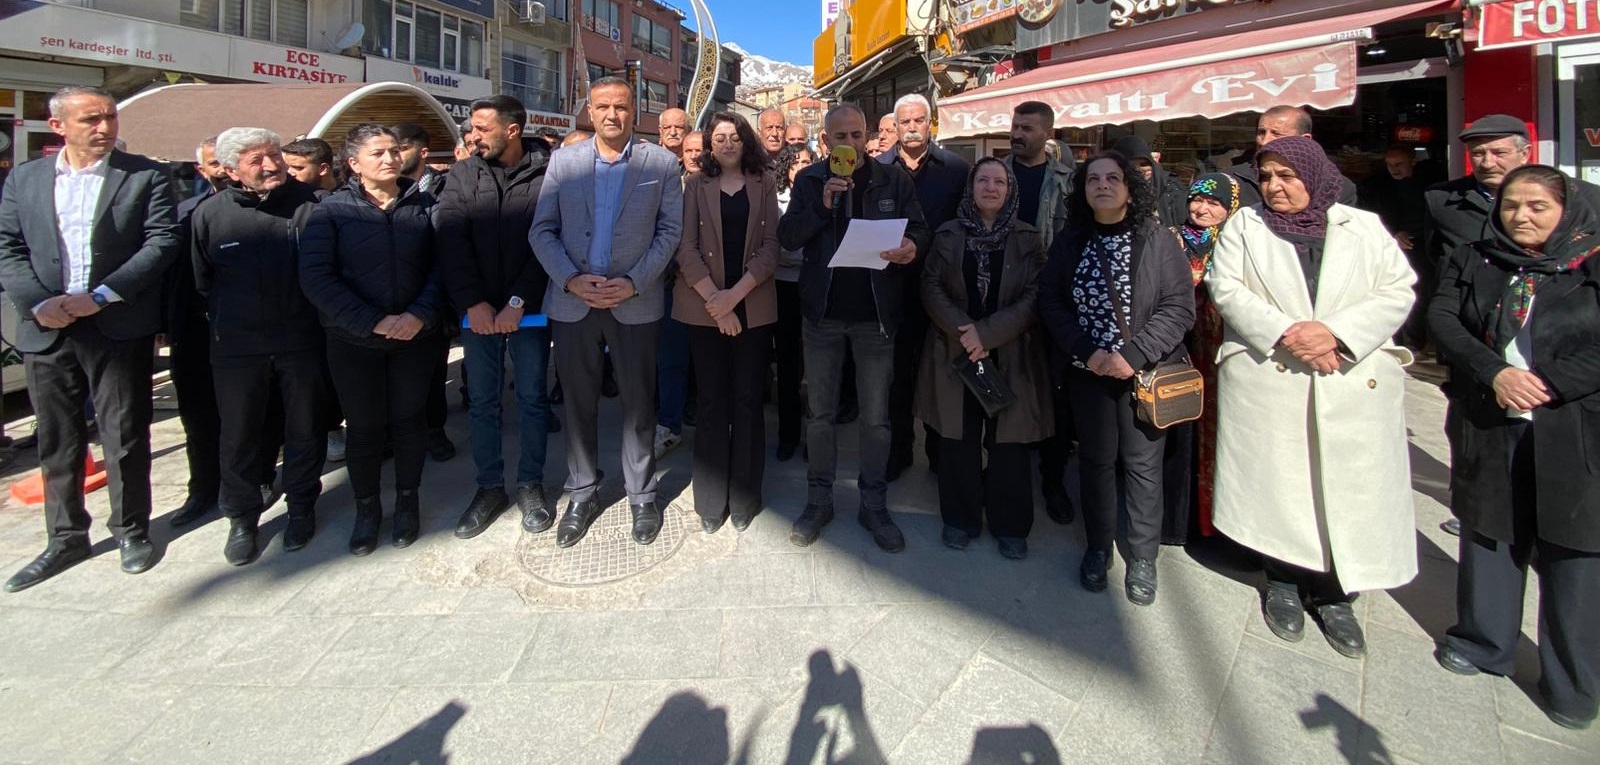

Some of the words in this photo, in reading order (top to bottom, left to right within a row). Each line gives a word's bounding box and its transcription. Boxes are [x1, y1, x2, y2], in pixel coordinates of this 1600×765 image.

[1513, 0, 1600, 37] FOT
[40, 36, 65, 47] şen
[69, 39, 129, 56] kardeşler
[136, 48, 155, 60] ltd.
[286, 50, 320, 67] ECE
[253, 62, 347, 84] KIRTASİYE
[424, 71, 459, 88] kalde
[952, 91, 1169, 130] Kavaltı
[1191, 63, 1341, 104] Evi
[530, 114, 570, 128] LOKANTASI
